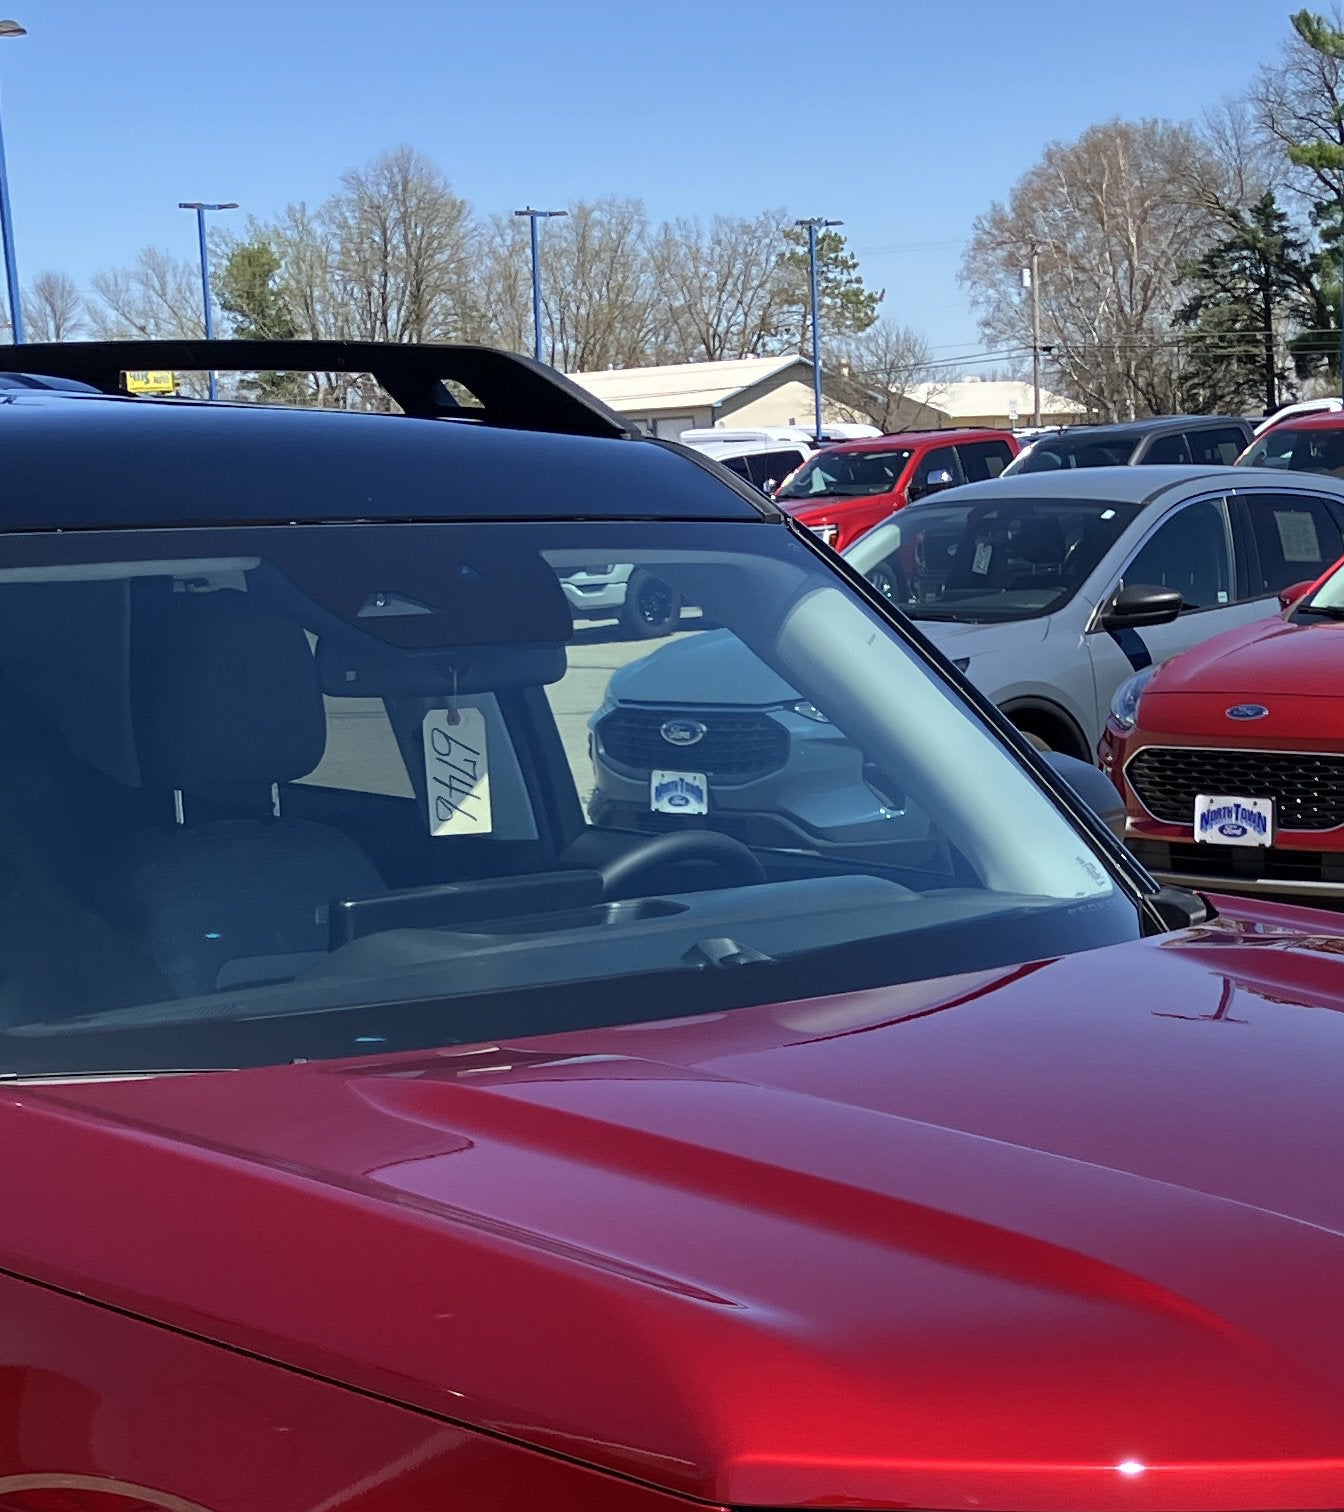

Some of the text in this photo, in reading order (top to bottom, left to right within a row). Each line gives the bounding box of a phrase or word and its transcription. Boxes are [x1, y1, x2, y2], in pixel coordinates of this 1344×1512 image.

[431, 727, 481, 822] 6746
[1200, 803, 1267, 835] NORTH TOWN
